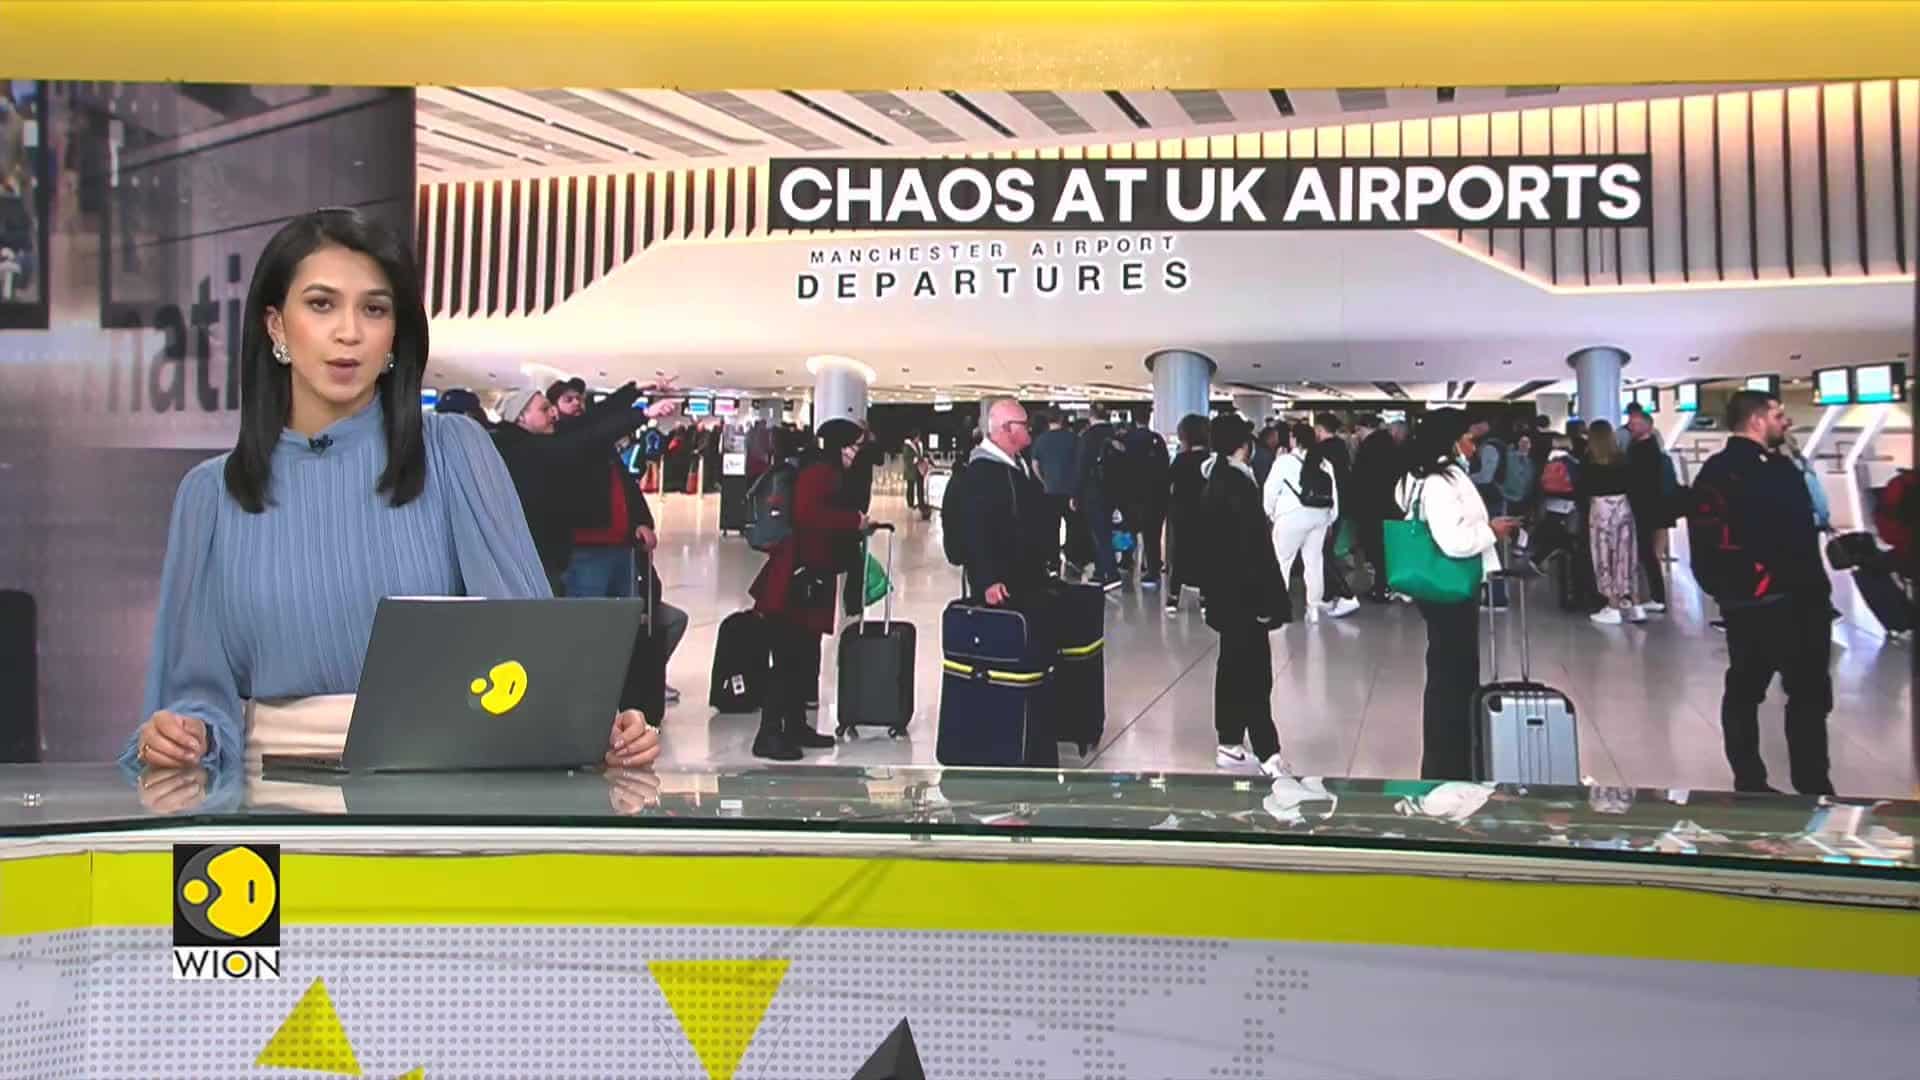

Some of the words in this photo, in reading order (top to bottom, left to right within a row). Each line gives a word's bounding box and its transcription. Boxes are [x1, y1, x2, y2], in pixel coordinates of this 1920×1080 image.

[779, 167, 1035, 223] CHAOS
[1052, 167, 1147, 222] AT
[1165, 167, 1266, 222] UK
[1283, 163, 1642, 221] AIRPORTS
[810, 243, 1004, 264] MANCHESTER
[1031, 235, 1177, 257] AIRPORT
[797, 263, 1188, 299] DEPARTURES
